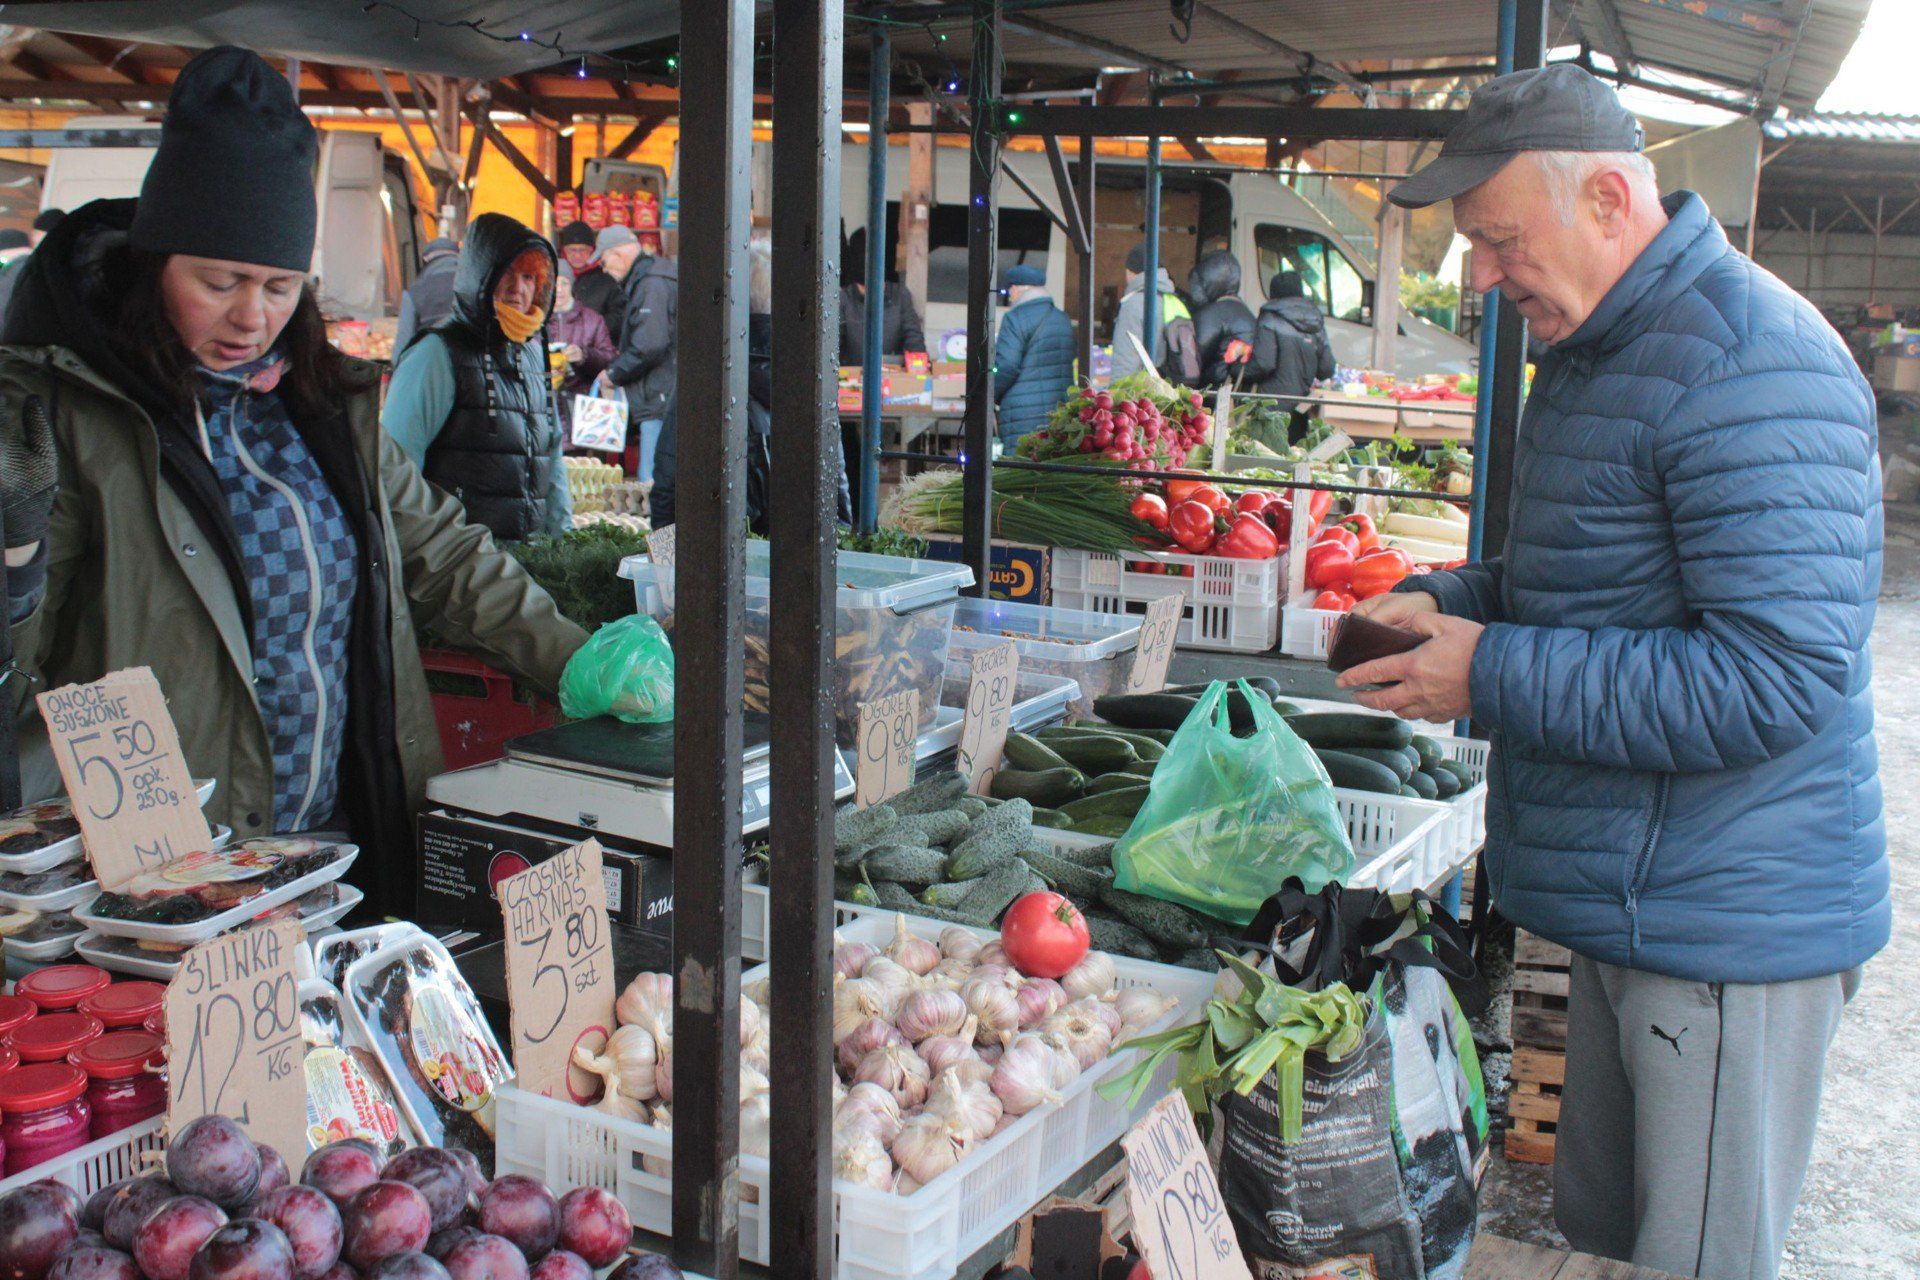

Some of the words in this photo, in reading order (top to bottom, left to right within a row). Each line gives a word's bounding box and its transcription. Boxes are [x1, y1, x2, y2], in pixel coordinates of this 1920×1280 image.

[47, 685, 106, 714] OWOCE
[894, 712, 913, 748] 80
[67, 732, 124, 820] 5
[112, 720, 156, 760] 50
[565, 904, 597, 957] 80
[253, 971, 296, 1041] 80
[1303, 1221, 1344, 1234] Recycled
